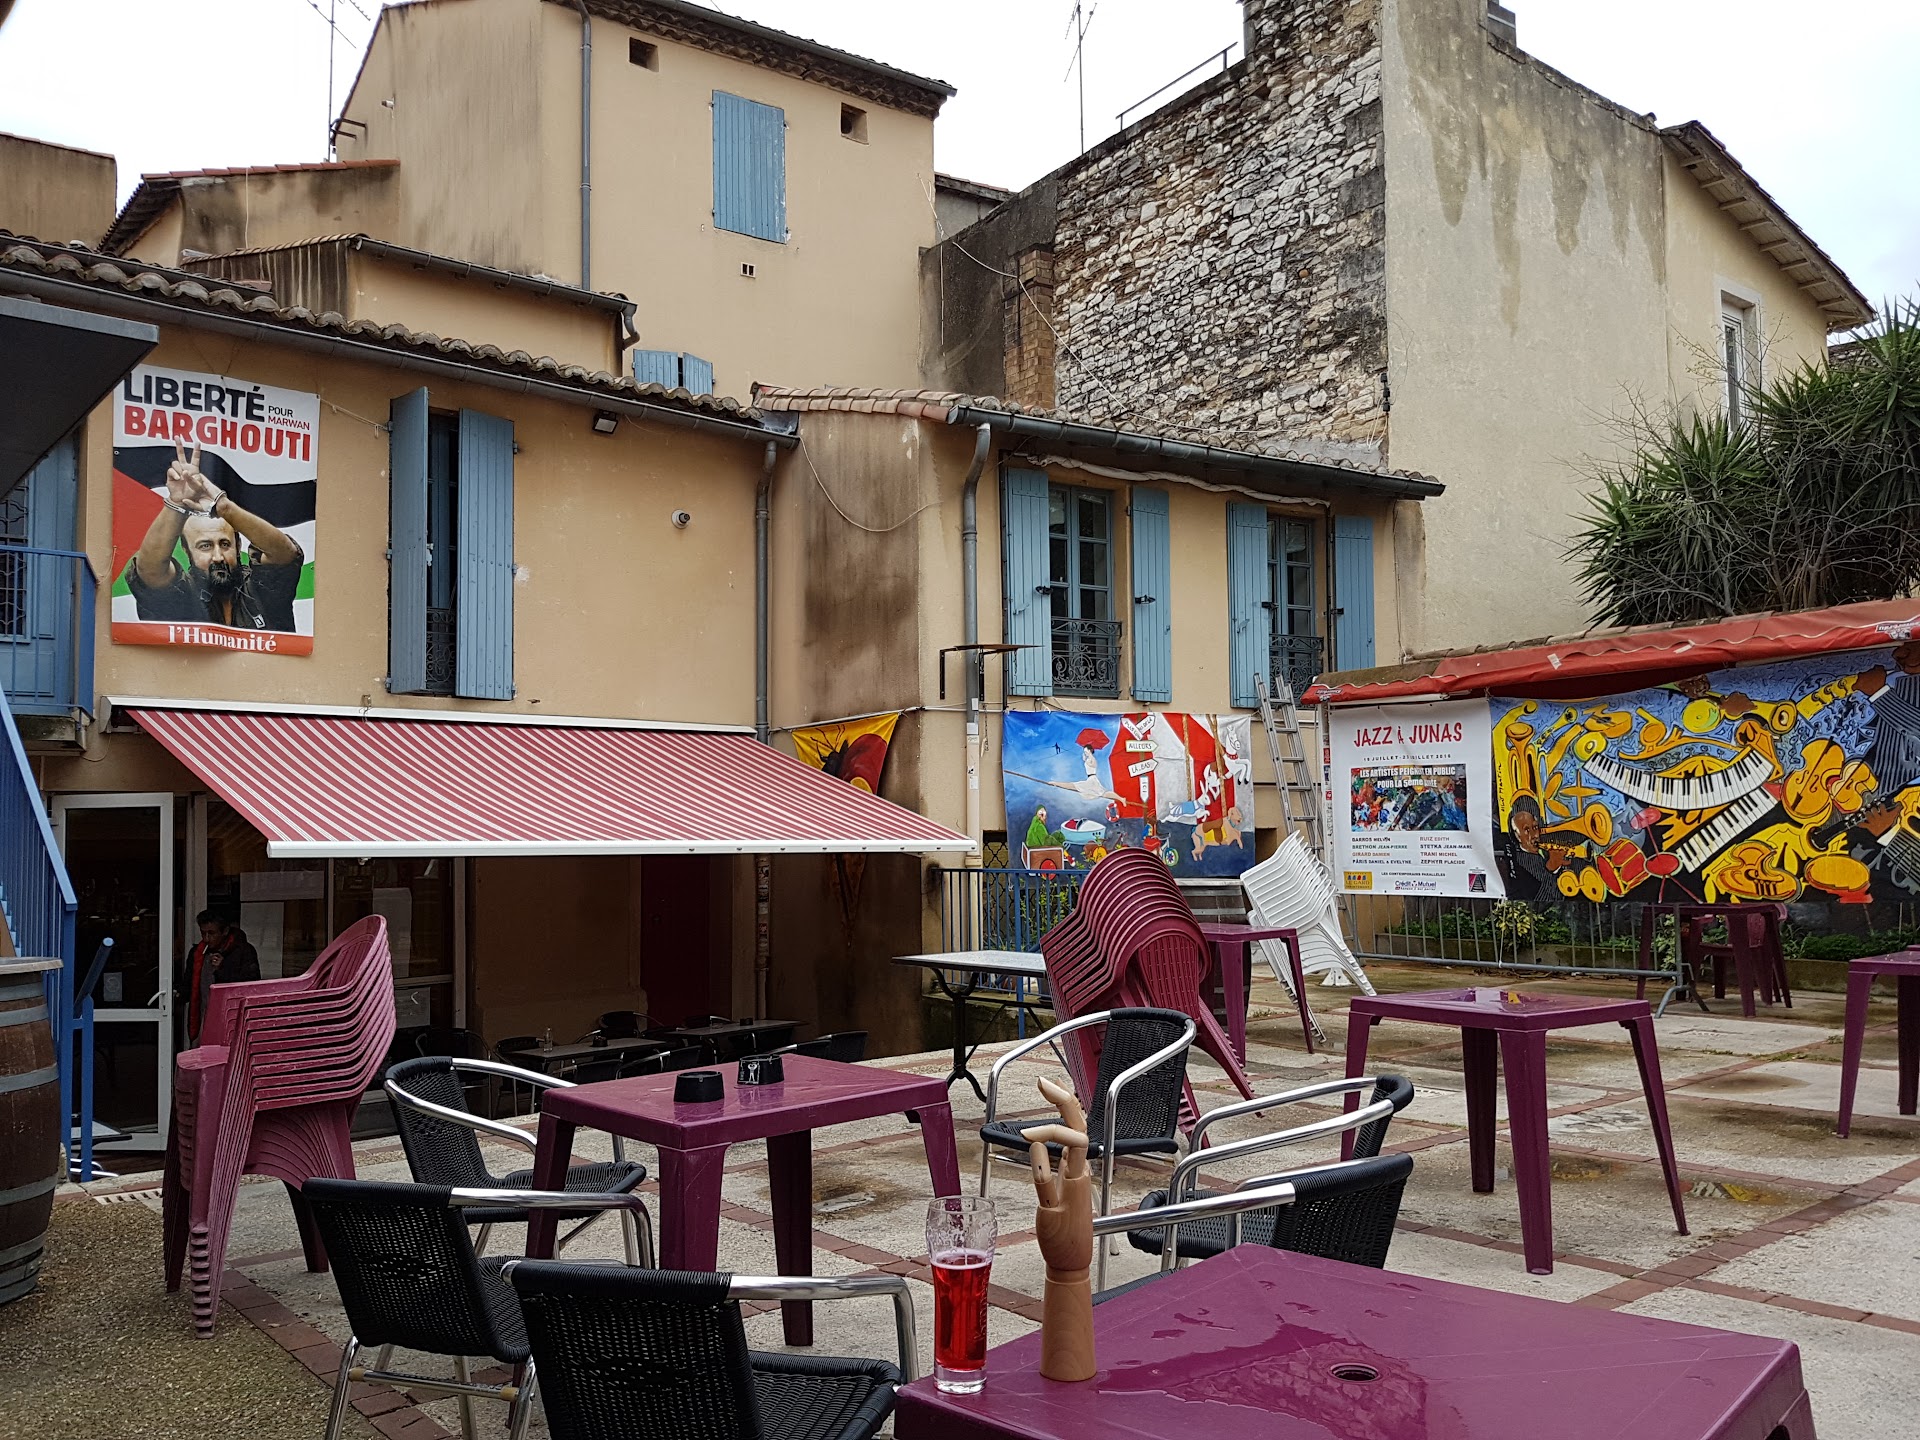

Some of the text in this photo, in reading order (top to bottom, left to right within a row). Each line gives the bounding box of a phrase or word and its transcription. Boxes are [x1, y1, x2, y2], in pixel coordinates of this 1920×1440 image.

[124, 373, 265, 422] LIBERTÉ
[268, 405, 293, 418] POUR
[268, 416, 310, 431] MARWAN
[124, 406, 311, 462] BARGHOUTI
[1354, 726, 1393, 748] JAZZ
[1409, 722, 1462, 744] JUNAS
[1370, 768, 1398, 777] ARTISTES
[1433, 766, 1456, 775] PUBLIC
[1377, 780, 1394, 788] POUR
